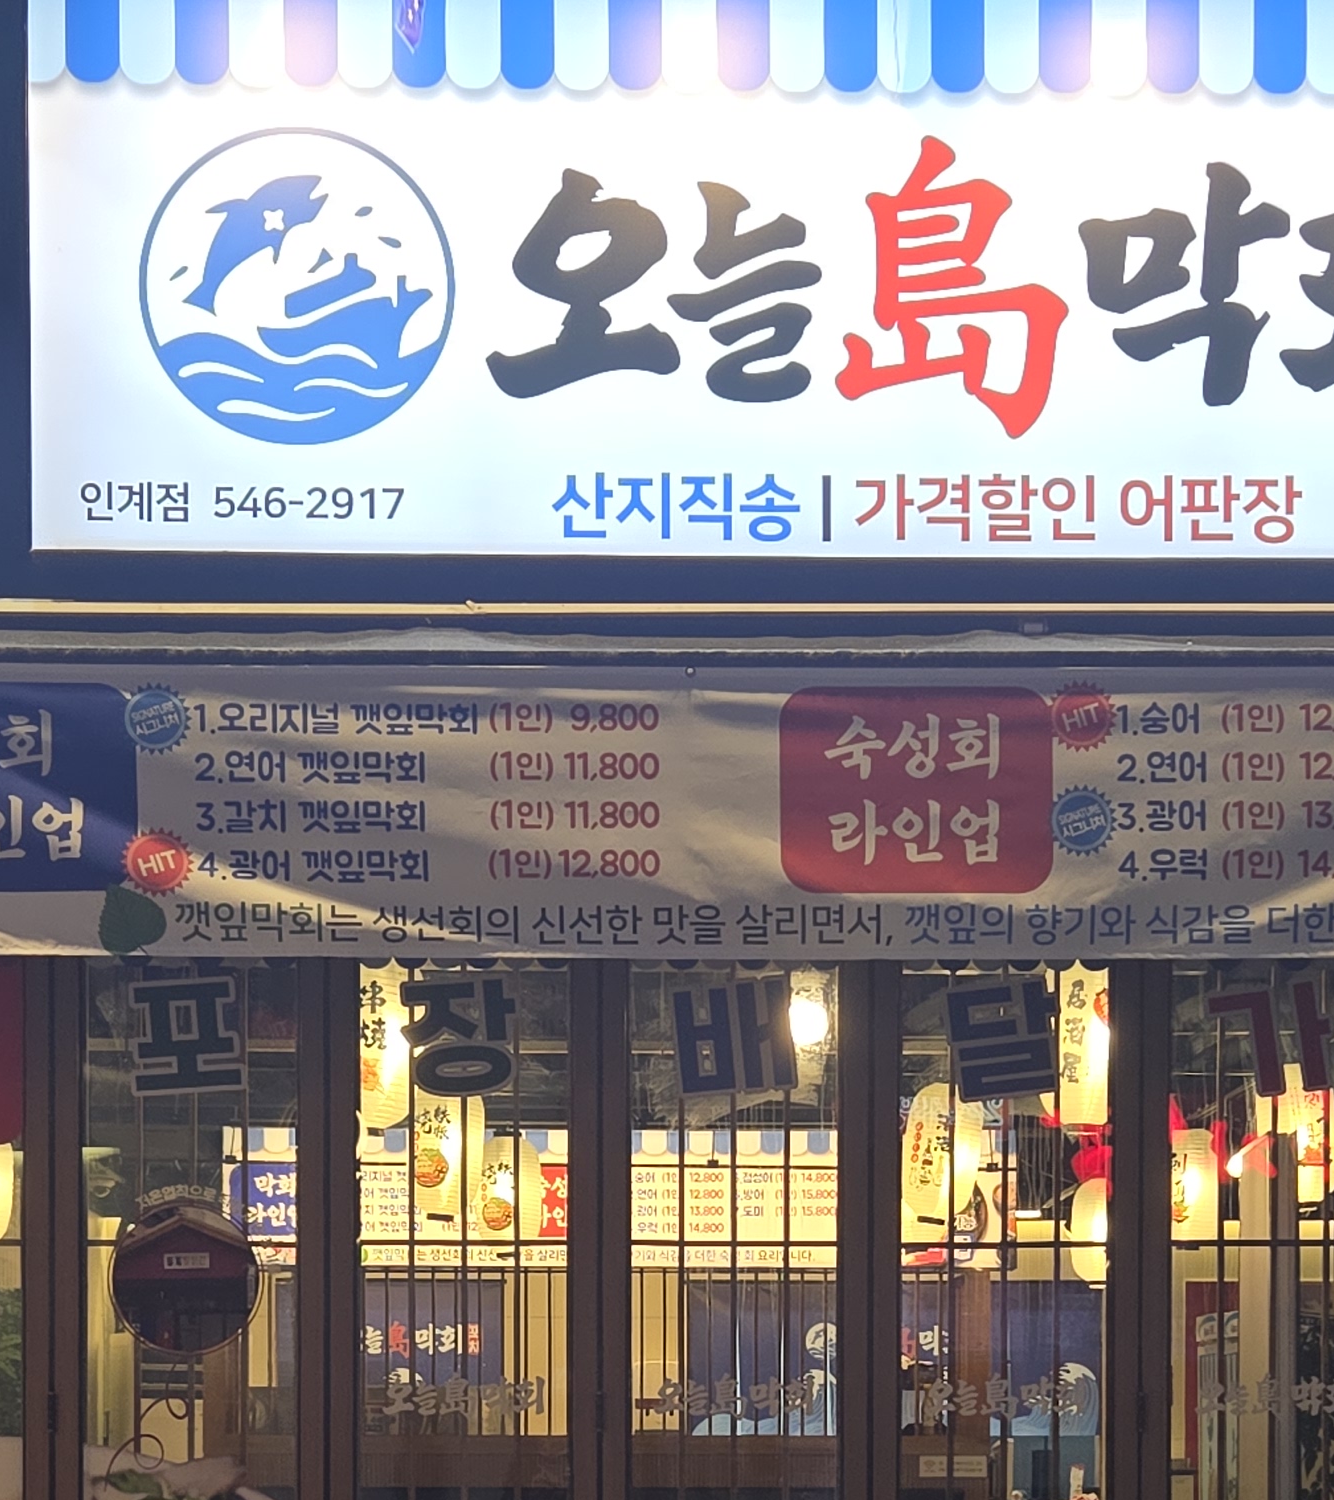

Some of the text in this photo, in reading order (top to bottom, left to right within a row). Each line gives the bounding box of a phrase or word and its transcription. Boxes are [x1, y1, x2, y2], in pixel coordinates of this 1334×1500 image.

[79, 481, 406, 525] 인계점 546-2917
[551, 473, 1304, 543] 산지직송 가격할인 어판장
[193, 703, 659, 736] 1.오리지널 깻잎막회 (1인) 9,800
[1062, 702, 1099, 731] HIT
[1116, 702, 1199, 735] 1.숭어
[1222, 703, 1285, 734] (1인)
[825, 713, 1000, 780] 숙성회
[195, 751, 659, 784] 2.연어 깻잎막회 (1인) 11,800
[1117, 752, 1208, 783] 2.연어
[1222, 752, 1285, 783] (1인)
[196, 800, 659, 834] 3.갈치 깻잎막회 (1인) 11,800
[828, 799, 1000, 866] 라인업
[1118, 801, 1208, 832] 3.광어
[1222, 801, 1285, 831] (1인)
[137, 849, 177, 877] HIT
[197, 849, 660, 882] 4.광어 깻잎막회 (1인) 12,800
[1118, 850, 1208, 881] 4.우럭
[1222, 850, 1285, 881] (1인)
[174, 901, 363, 943] 깻잎막회는
[373, 904, 520, 943] 생선회의
[532, 906, 642, 945] 신선한
[654, 906, 725, 946] 맛을
[735, 904, 892, 947] 살리면서,
[904, 904, 1013, 945] 깻잎의
[1027, 904, 1136, 945] 향기와
[1146, 904, 1254, 945] 식감을
[361, 1321, 463, 1358] 늘島막회
